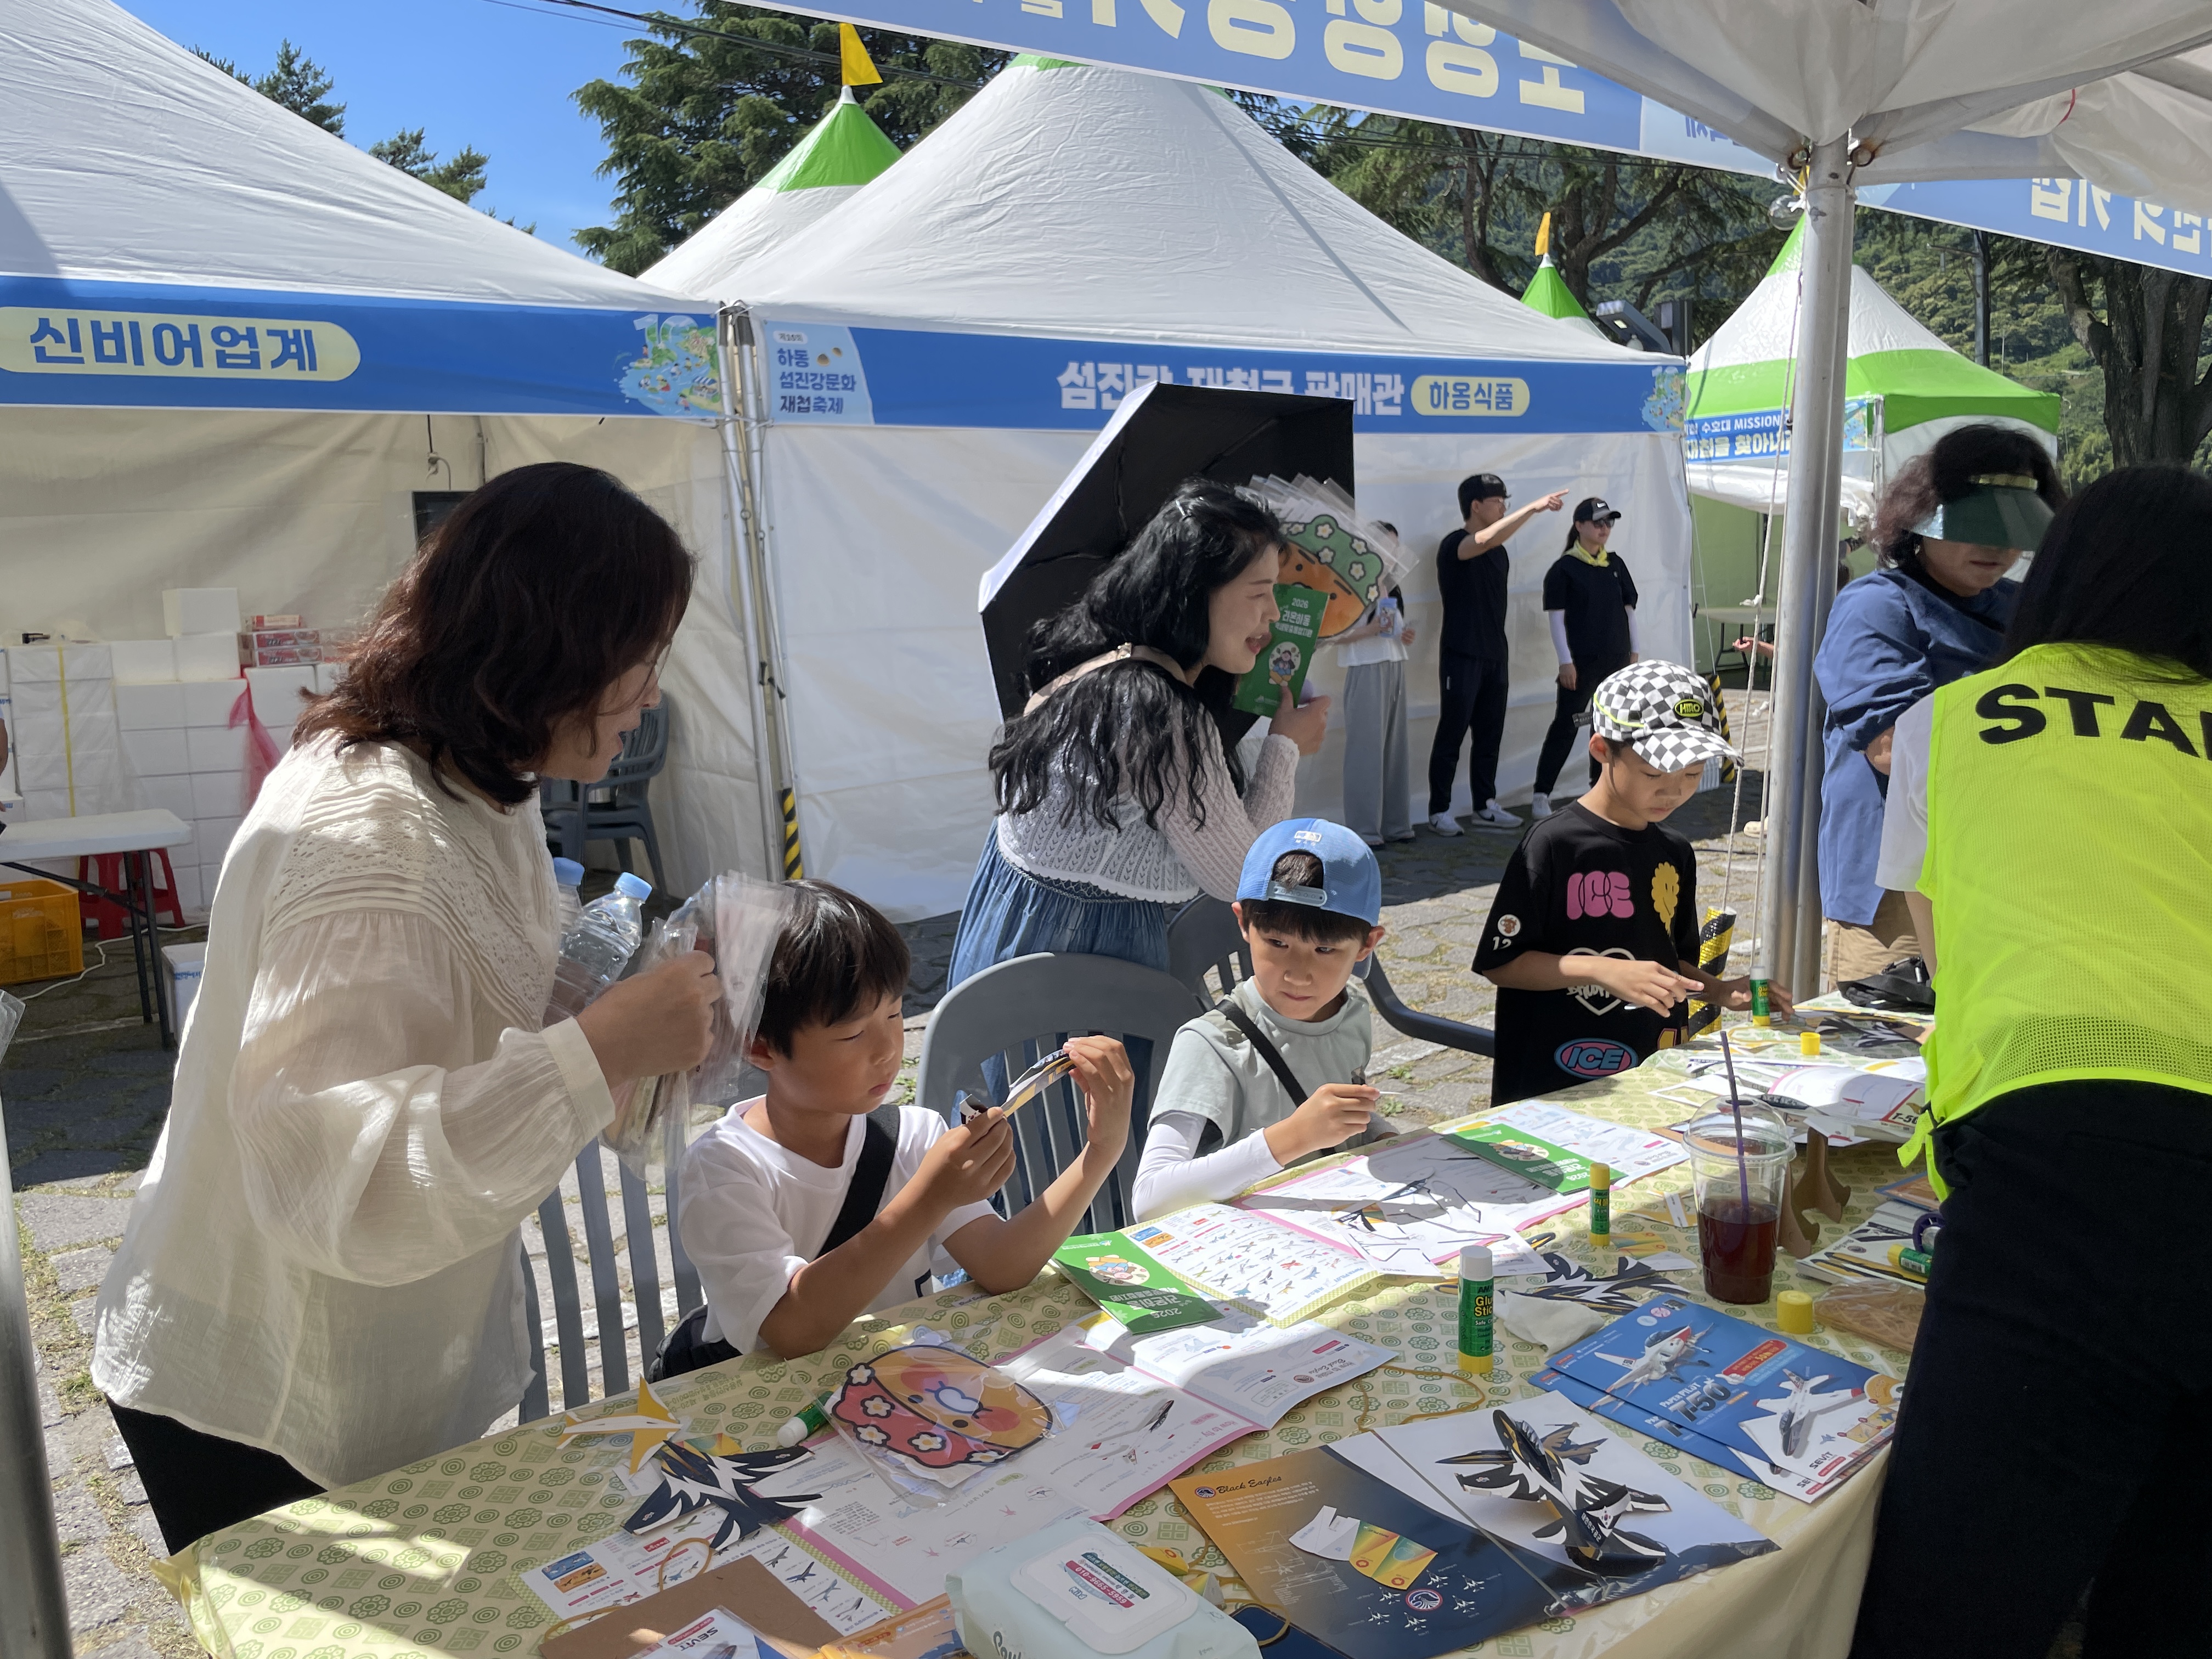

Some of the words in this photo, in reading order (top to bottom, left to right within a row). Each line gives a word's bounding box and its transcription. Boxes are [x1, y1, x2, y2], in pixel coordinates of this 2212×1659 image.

[30, 317, 318, 371] 신비어업계
[777, 348, 809, 368] 하동
[780, 371, 857, 392] 섬진강문화
[780, 395, 844, 414] 재첩축제
[1429, 381, 1514, 411] 하옹식품
[1701, 419, 1731, 434] 수호대
[1734, 415, 1780, 431] MISSION
[1566, 870, 1635, 921] ICE
[1567, 1046, 1626, 1070] ICE
[1150, 1307, 1182, 1319] 2026
[1660, 1390, 1680, 1408] PAPER
[1677, 1380, 1702, 1401] PILOT
[1668, 1382, 1731, 1423] T-50
[1217, 1482, 1246, 1494] Black
[1249, 1475, 1282, 1489] Eagles
[1075, 1566, 1127, 1604] 010-9665-5959
